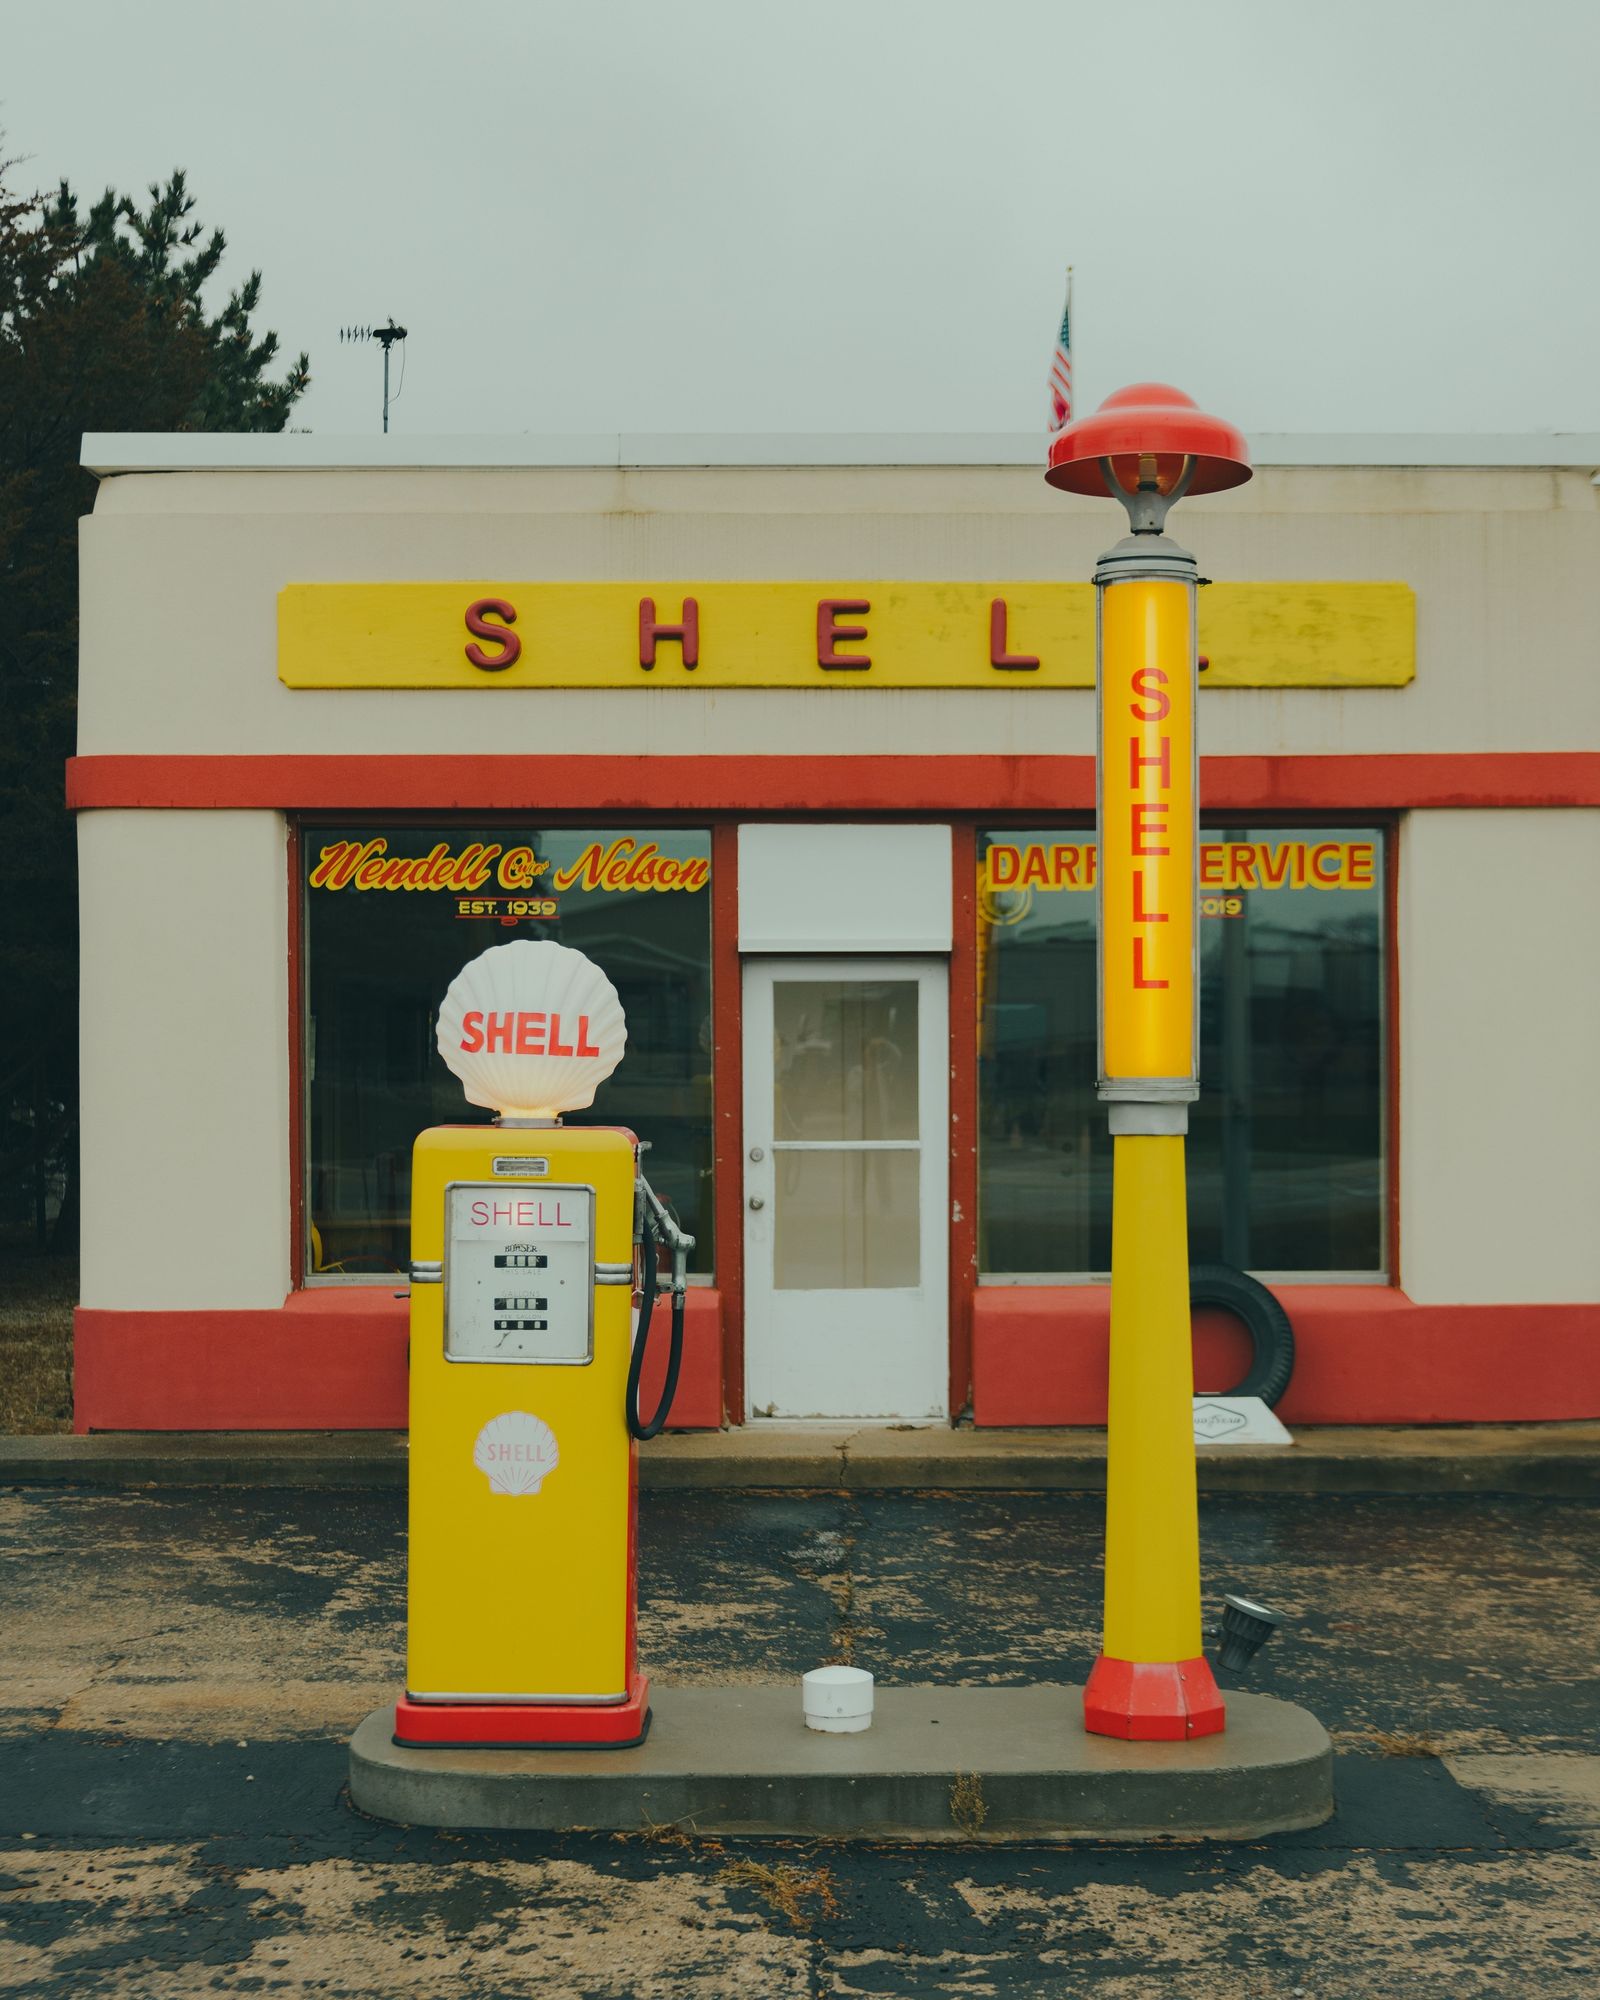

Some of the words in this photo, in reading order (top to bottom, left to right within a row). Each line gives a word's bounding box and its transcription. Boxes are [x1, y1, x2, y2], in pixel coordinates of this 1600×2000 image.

[464, 597, 1208, 671] SHEL
[1129, 667, 1171, 989] SHELL
[309, 837, 503, 891] Wendell
[553, 836, 711, 892] Nelson
[1200, 842, 1376, 890] ERVICE
[458, 901, 498, 915] EST.
[507, 901, 558, 915] 1939
[1200, 898, 1242, 915] 019
[460, 1011, 600, 1058] SHELL
[471, 1201, 572, 1226] SHELL
[487, 1443, 546, 1462] SHELL
